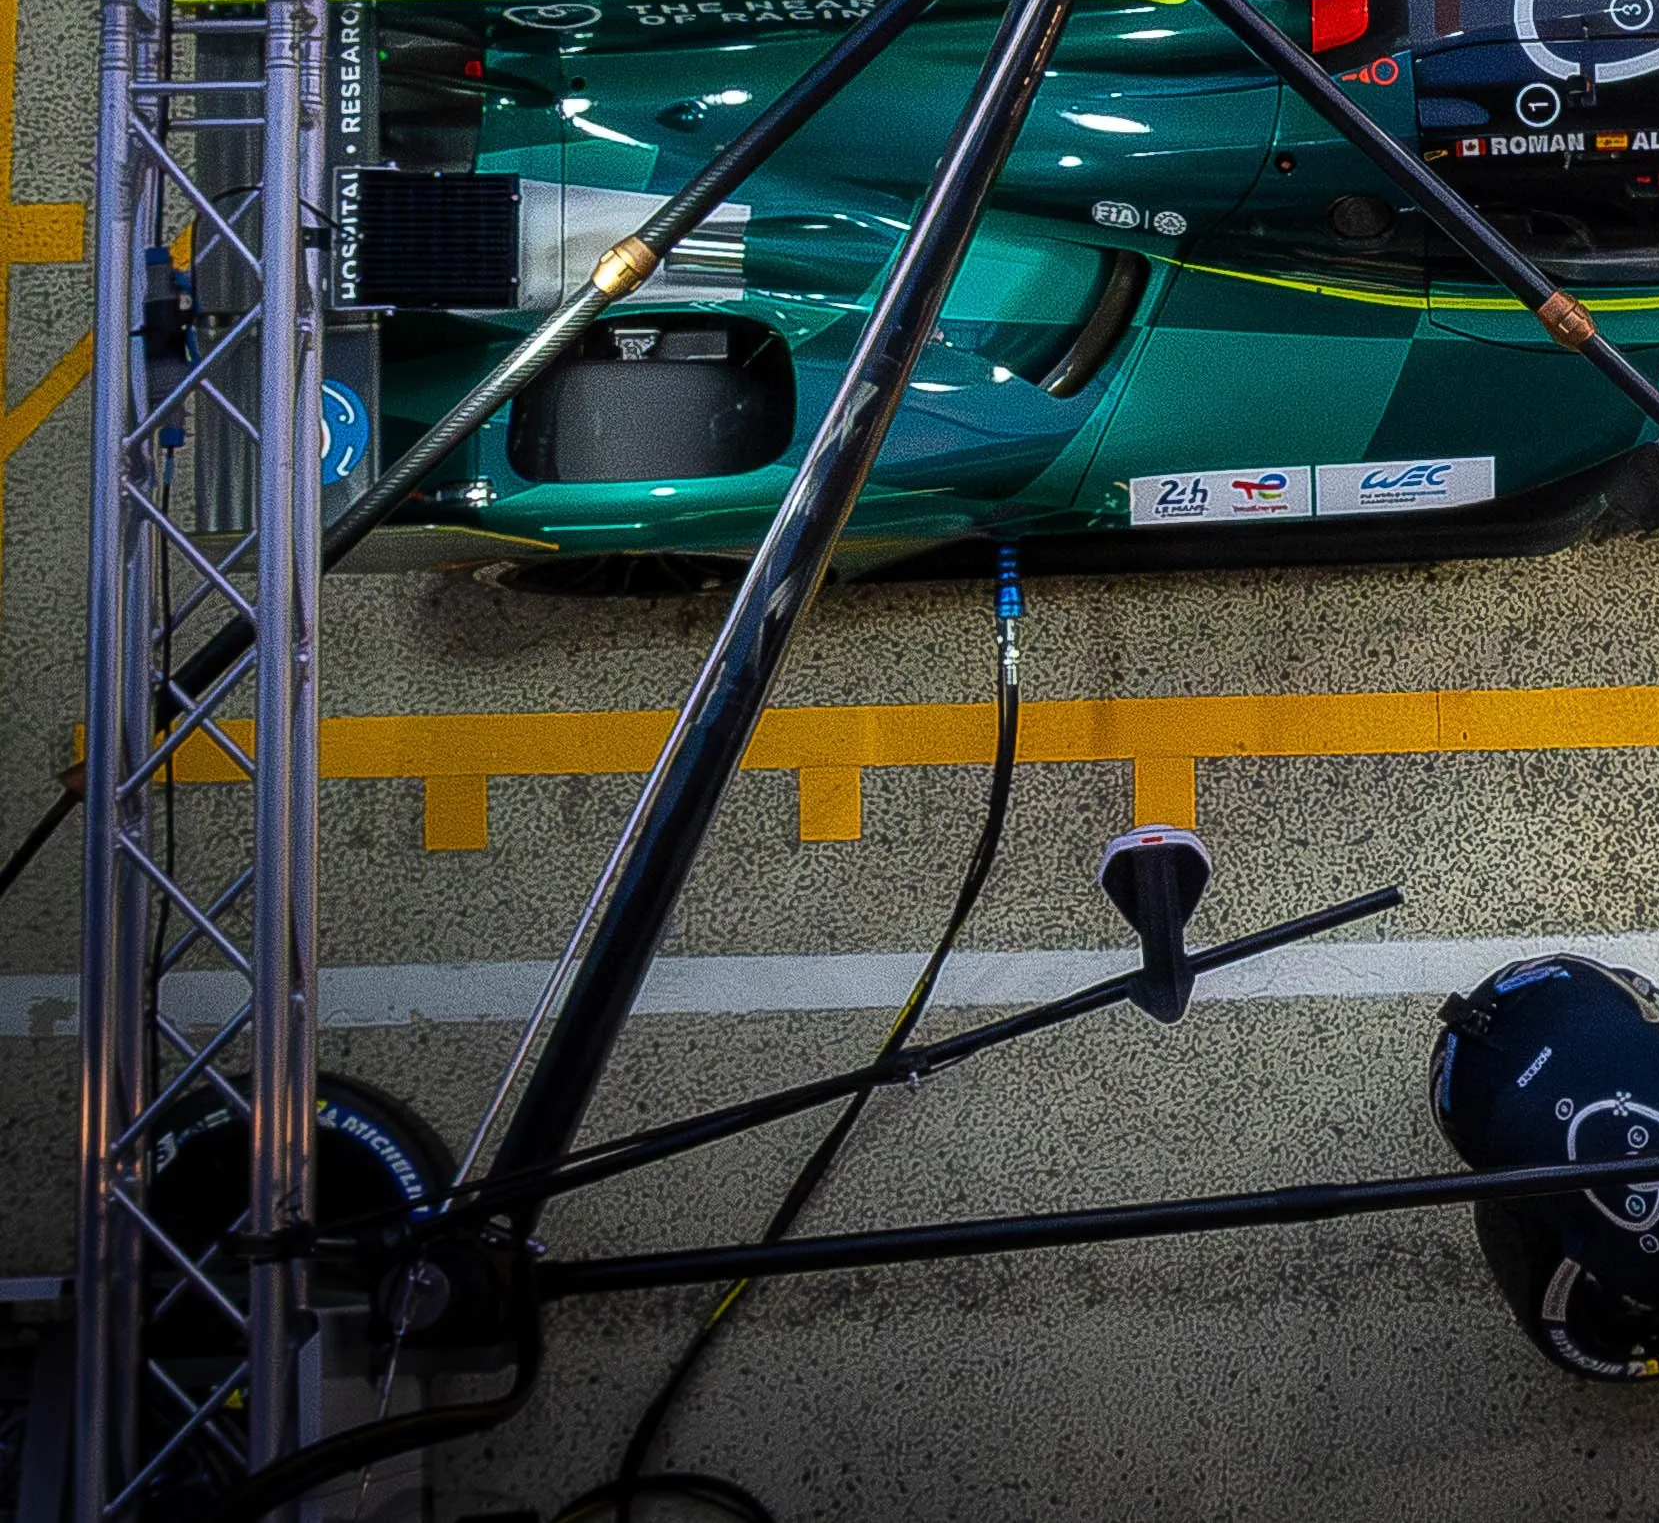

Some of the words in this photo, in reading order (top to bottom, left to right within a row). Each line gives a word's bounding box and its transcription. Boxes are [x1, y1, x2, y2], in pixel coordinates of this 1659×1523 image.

[627, 1, 723, 15] THE
[1622, 3, 1641, 16] 3
[639, 13, 697, 26] OF
[721, 9, 872, 23] RACIN
[1528, 102, 1549, 112] 1
[1491, 133, 1585, 155] ROMAN
[1360, 464, 1451, 491] WEC
